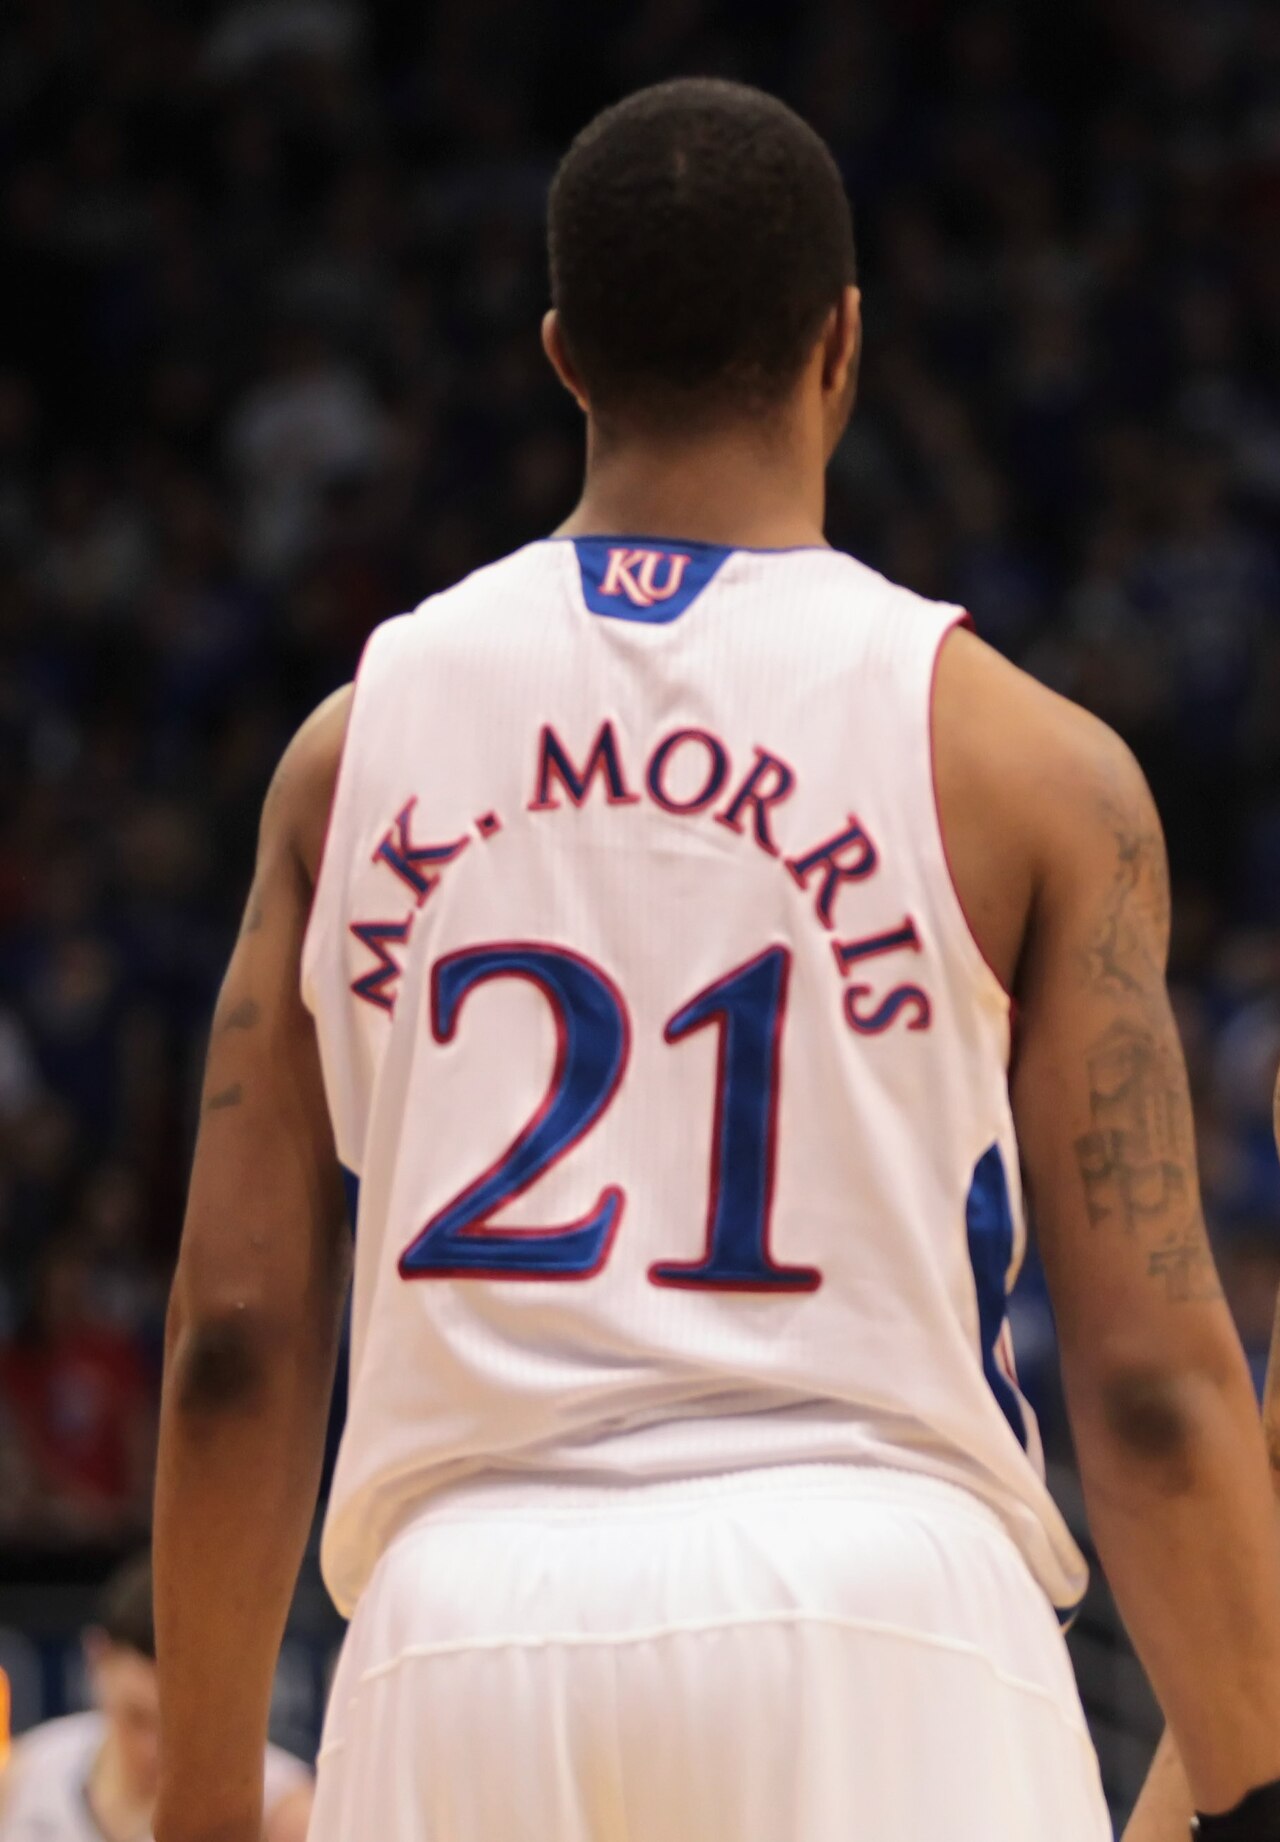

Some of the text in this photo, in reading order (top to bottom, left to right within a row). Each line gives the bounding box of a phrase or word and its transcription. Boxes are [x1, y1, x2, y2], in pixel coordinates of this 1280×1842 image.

[598, 548, 692, 607] KU
[527, 717, 932, 1037] MORRIS
[398, 941, 823, 1294] 21
